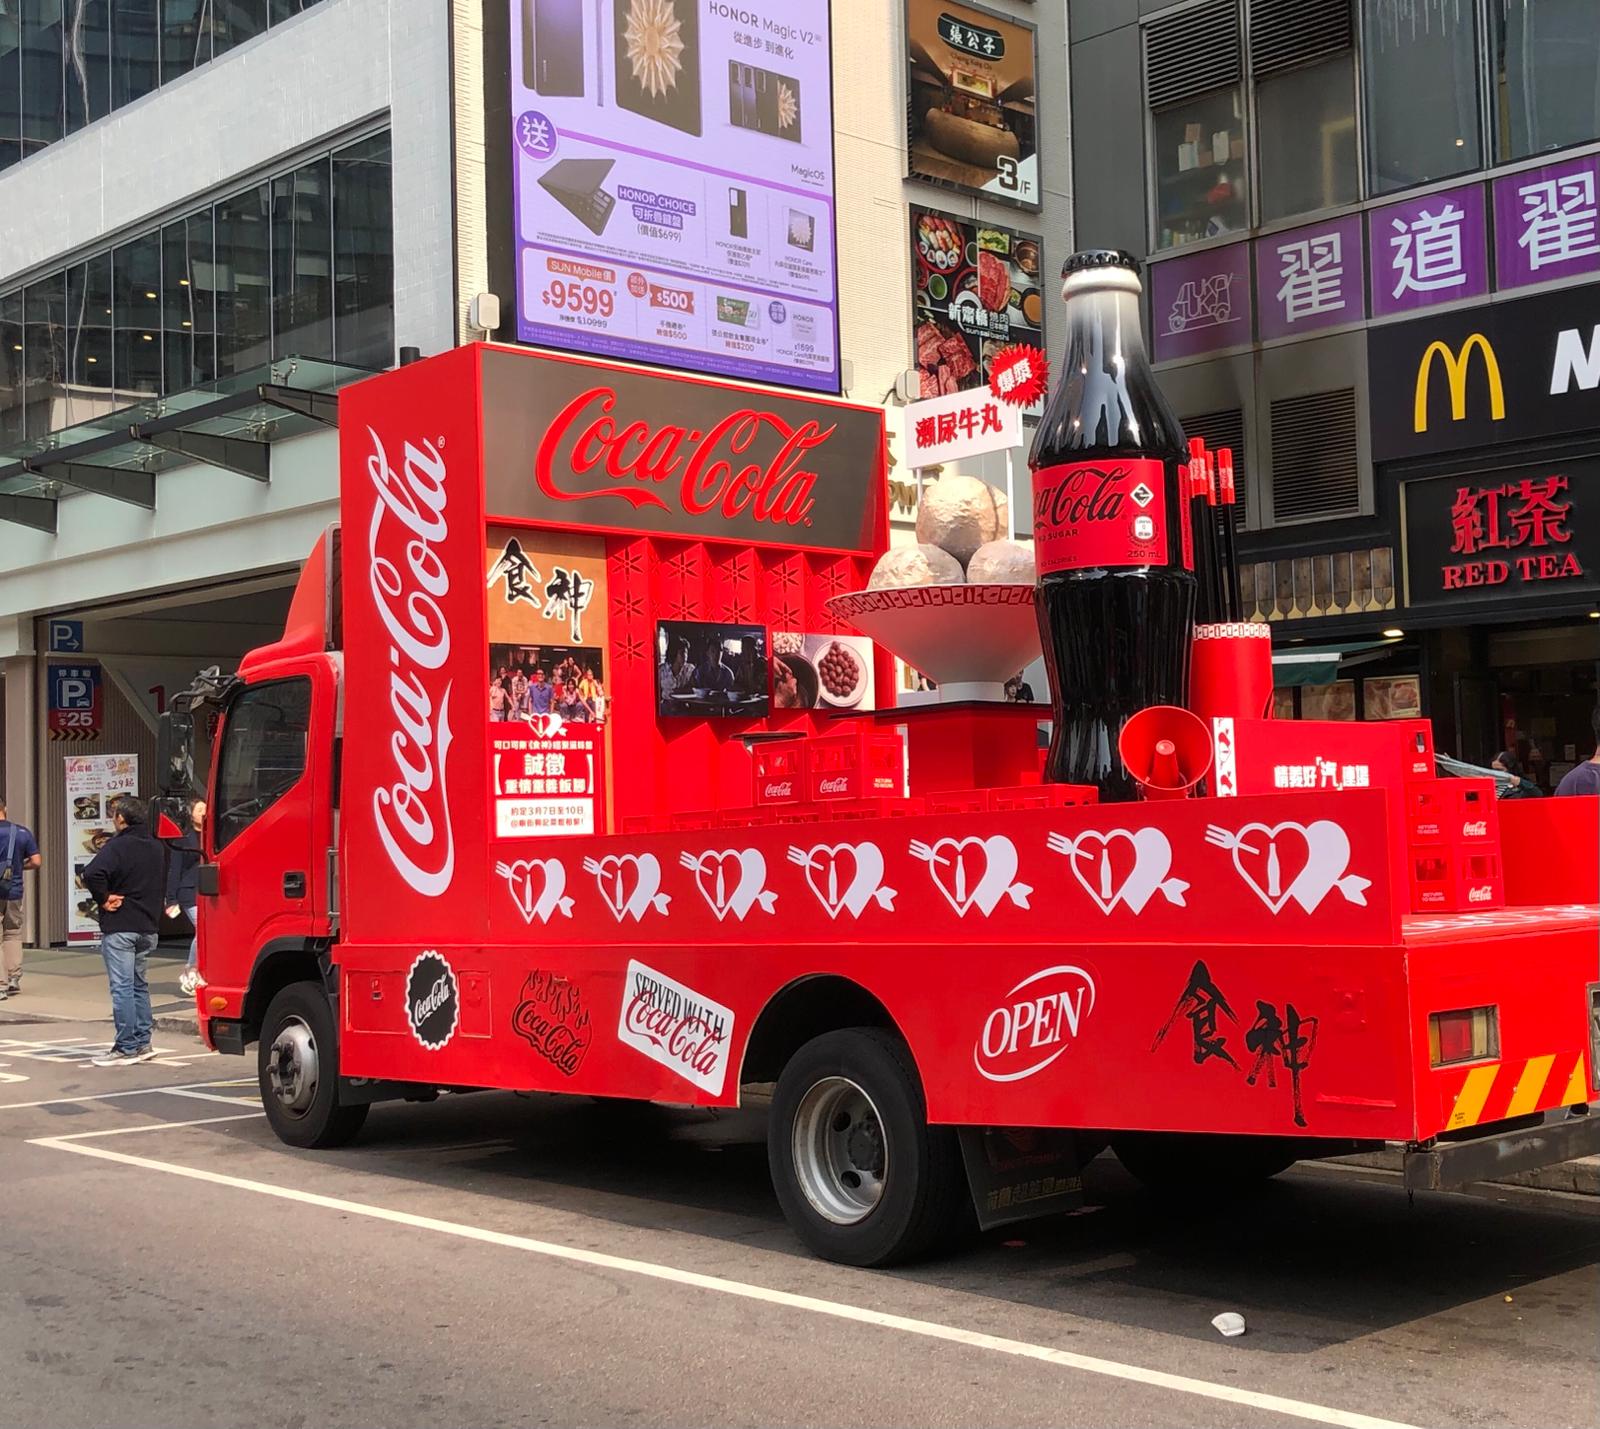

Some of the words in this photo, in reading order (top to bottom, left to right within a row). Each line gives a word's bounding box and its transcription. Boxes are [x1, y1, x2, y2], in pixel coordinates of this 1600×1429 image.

[709, 1, 759, 28] HONOR
[763, 18, 797, 40] Magic
[800, 29, 814, 45] V2
[950, 25, 996, 55] 張公子
[522, 116, 551, 152] 送
[791, 164, 825, 181] MagicOS
[997, 155, 1031, 195] 3/F
[618, 186, 655, 206] HONOR
[657, 194, 696, 214] CHOICE
[637, 224, 682, 243] (價值$699)
[551, 261, 572, 272] SUN
[574, 265, 602, 279] Mobile
[657, 290, 688, 309] $500
[577, 316, 608, 328] $10999
[535, 386, 838, 528] Coca-Cola
[1450, 475, 1572, 555] 紅茶
[1048, 528, 1078, 540] SUGAR
[1442, 560, 1510, 590] RED
[1516, 553, 1583, 581] TEA
[487, 537, 593, 643] 食神
[52, 624, 74, 650] P
[366, 424, 455, 899] Coca-Cola
[62, 680, 87, 708] P
[632, 971, 682, 1015] SERVED
[683, 1002, 725, 1044] WITH
[982, 987, 1086, 1058] OPEN
[625, 991, 728, 1076] Coca-Cola
[1151, 959, 1319, 1127] 食神
